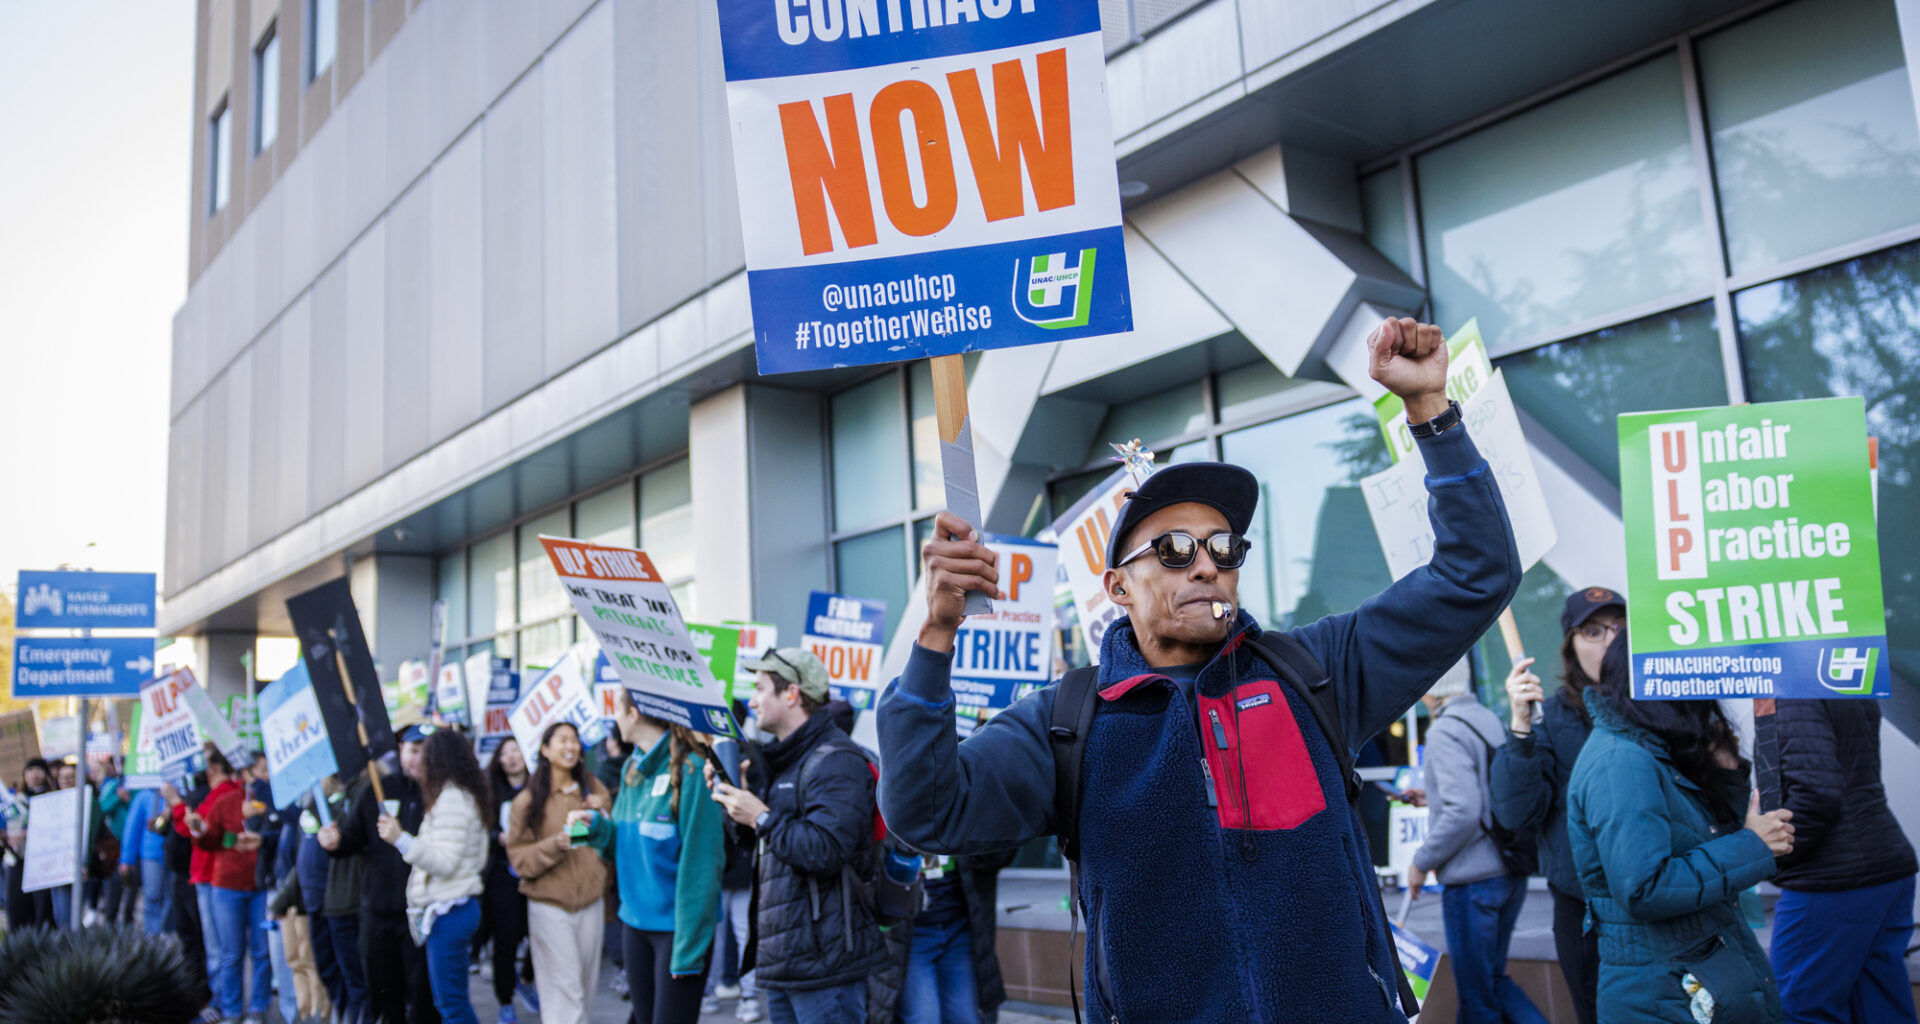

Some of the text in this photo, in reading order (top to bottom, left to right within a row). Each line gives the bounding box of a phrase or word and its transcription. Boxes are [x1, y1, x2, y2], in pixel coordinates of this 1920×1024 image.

[778, 47, 1075, 256] NOW
[823, 273, 956, 312] @unacuhcp
[796, 303, 992, 350] #TogetherWeRise
[554, 547, 650, 578] ULP STRIKE
[567, 583, 590, 599] WE
[592, 605, 674, 636] PATIENTS
[1665, 577, 1849, 646] STRIKE
[19, 645, 111, 667] Emergency
[622, 636, 662, 660] TEST
[956, 629, 1040, 672] TRIKE
[18, 666, 114, 688] Department
[1643, 655, 1782, 675] #UNACUHCPstrong
[523, 674, 563, 727] ULP
[1644, 675, 1774, 697] #TogetherWeWin
